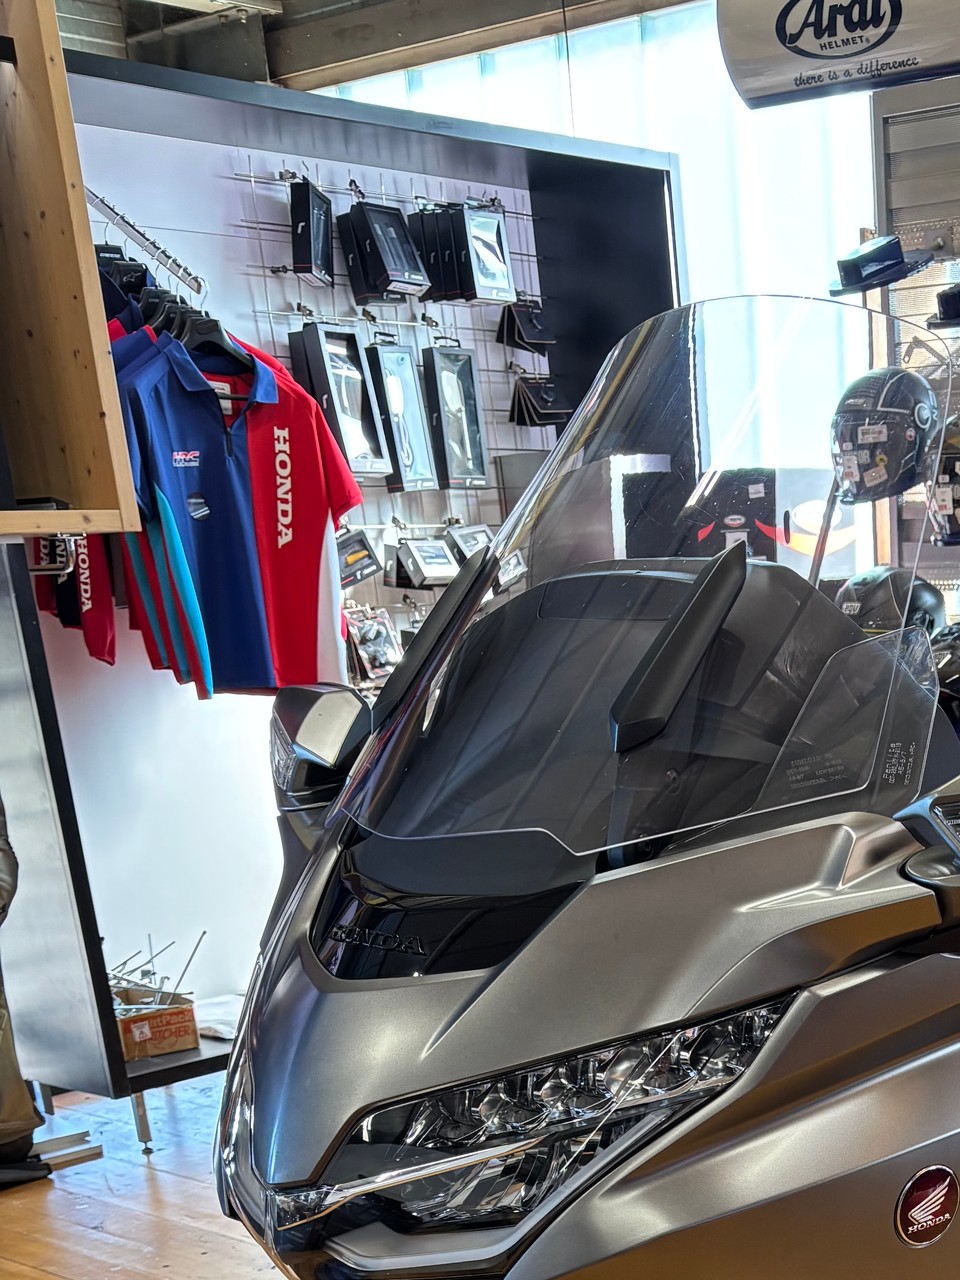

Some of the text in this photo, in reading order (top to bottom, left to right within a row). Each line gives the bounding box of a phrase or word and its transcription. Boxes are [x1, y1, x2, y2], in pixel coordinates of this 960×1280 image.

[819, 35, 865, 51] HELMET
[793, 56, 919, 88] there is a difference
[273, 426, 293, 549] HONDA
[77, 538, 92, 613] HONDA
[330, 923, 428, 957] HONDA
[907, 1212, 952, 1235] HONDA
